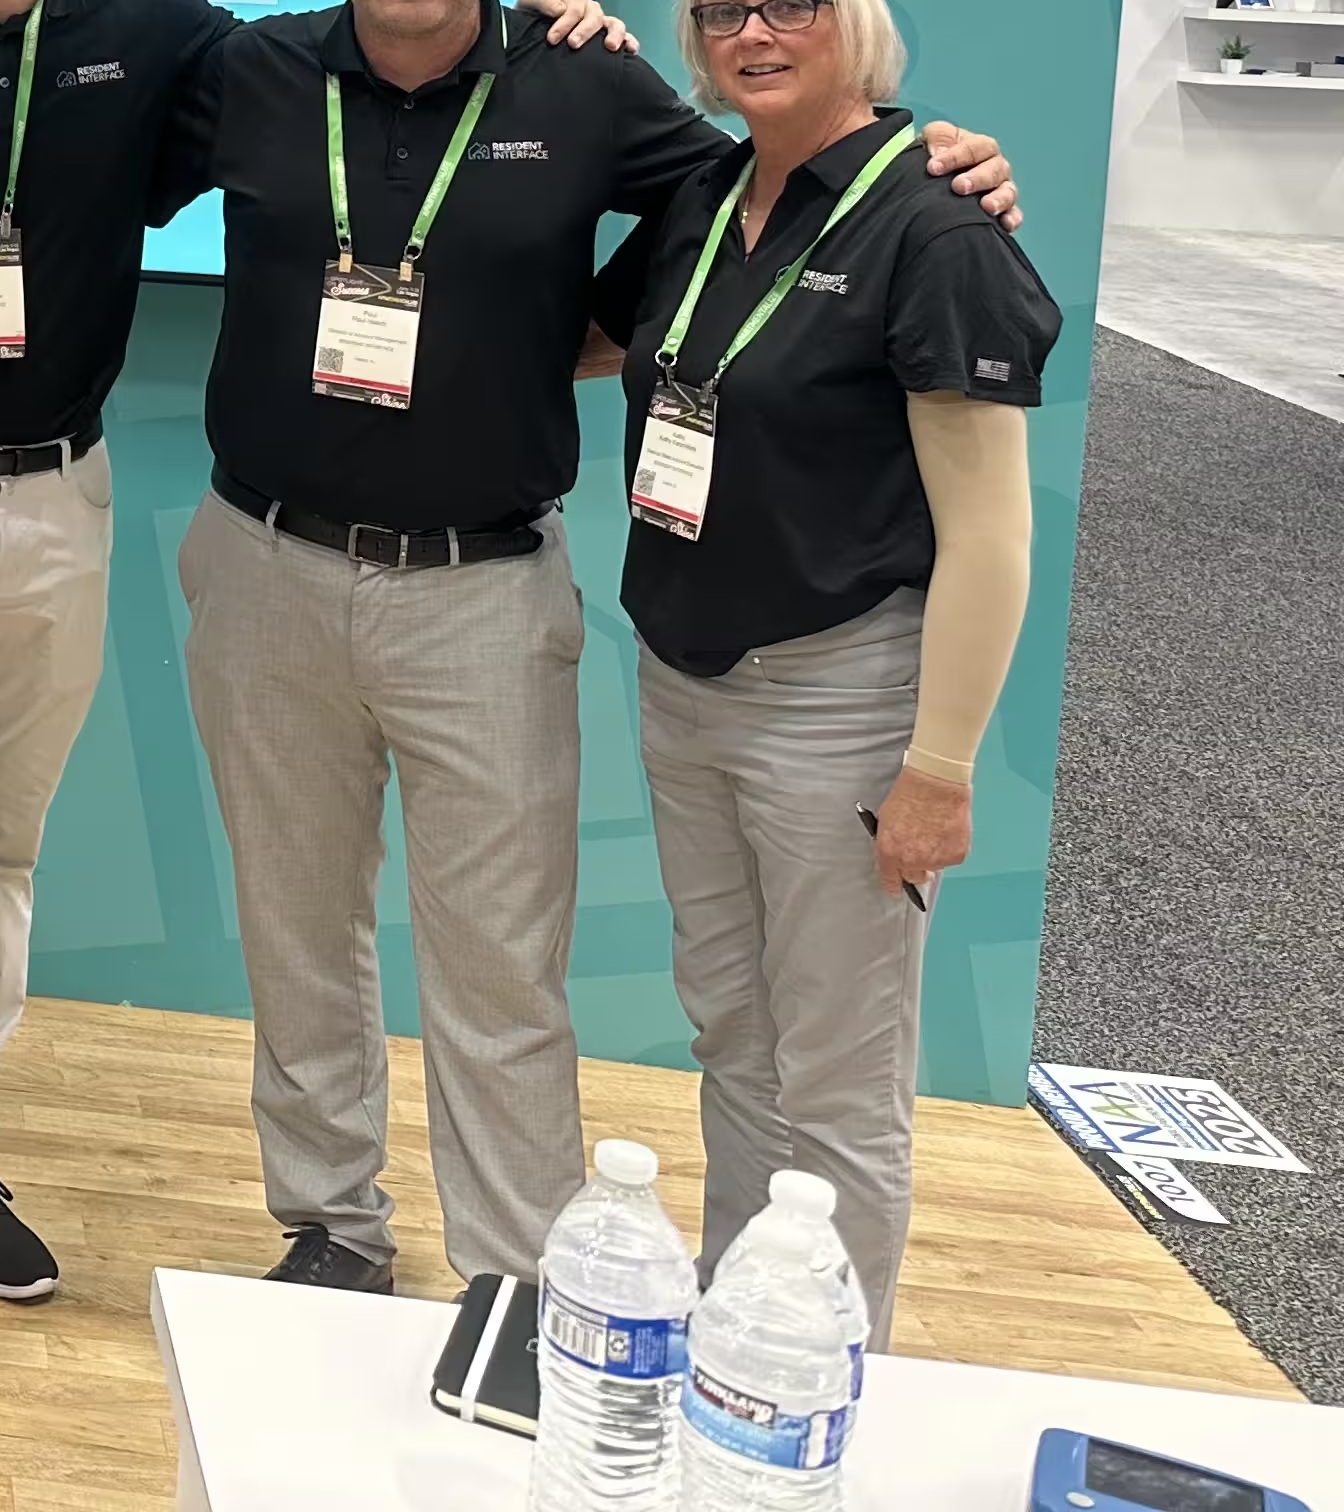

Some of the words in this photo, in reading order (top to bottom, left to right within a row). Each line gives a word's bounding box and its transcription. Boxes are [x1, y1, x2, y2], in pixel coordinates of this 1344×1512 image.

[76, 61, 120, 76] RESIDENT
[78, 69, 126, 84] INTERFACE
[492, 141, 544, 151] RESIDENT
[492, 149, 549, 160] INTERFACE
[802, 269, 848, 284] RESIDENT
